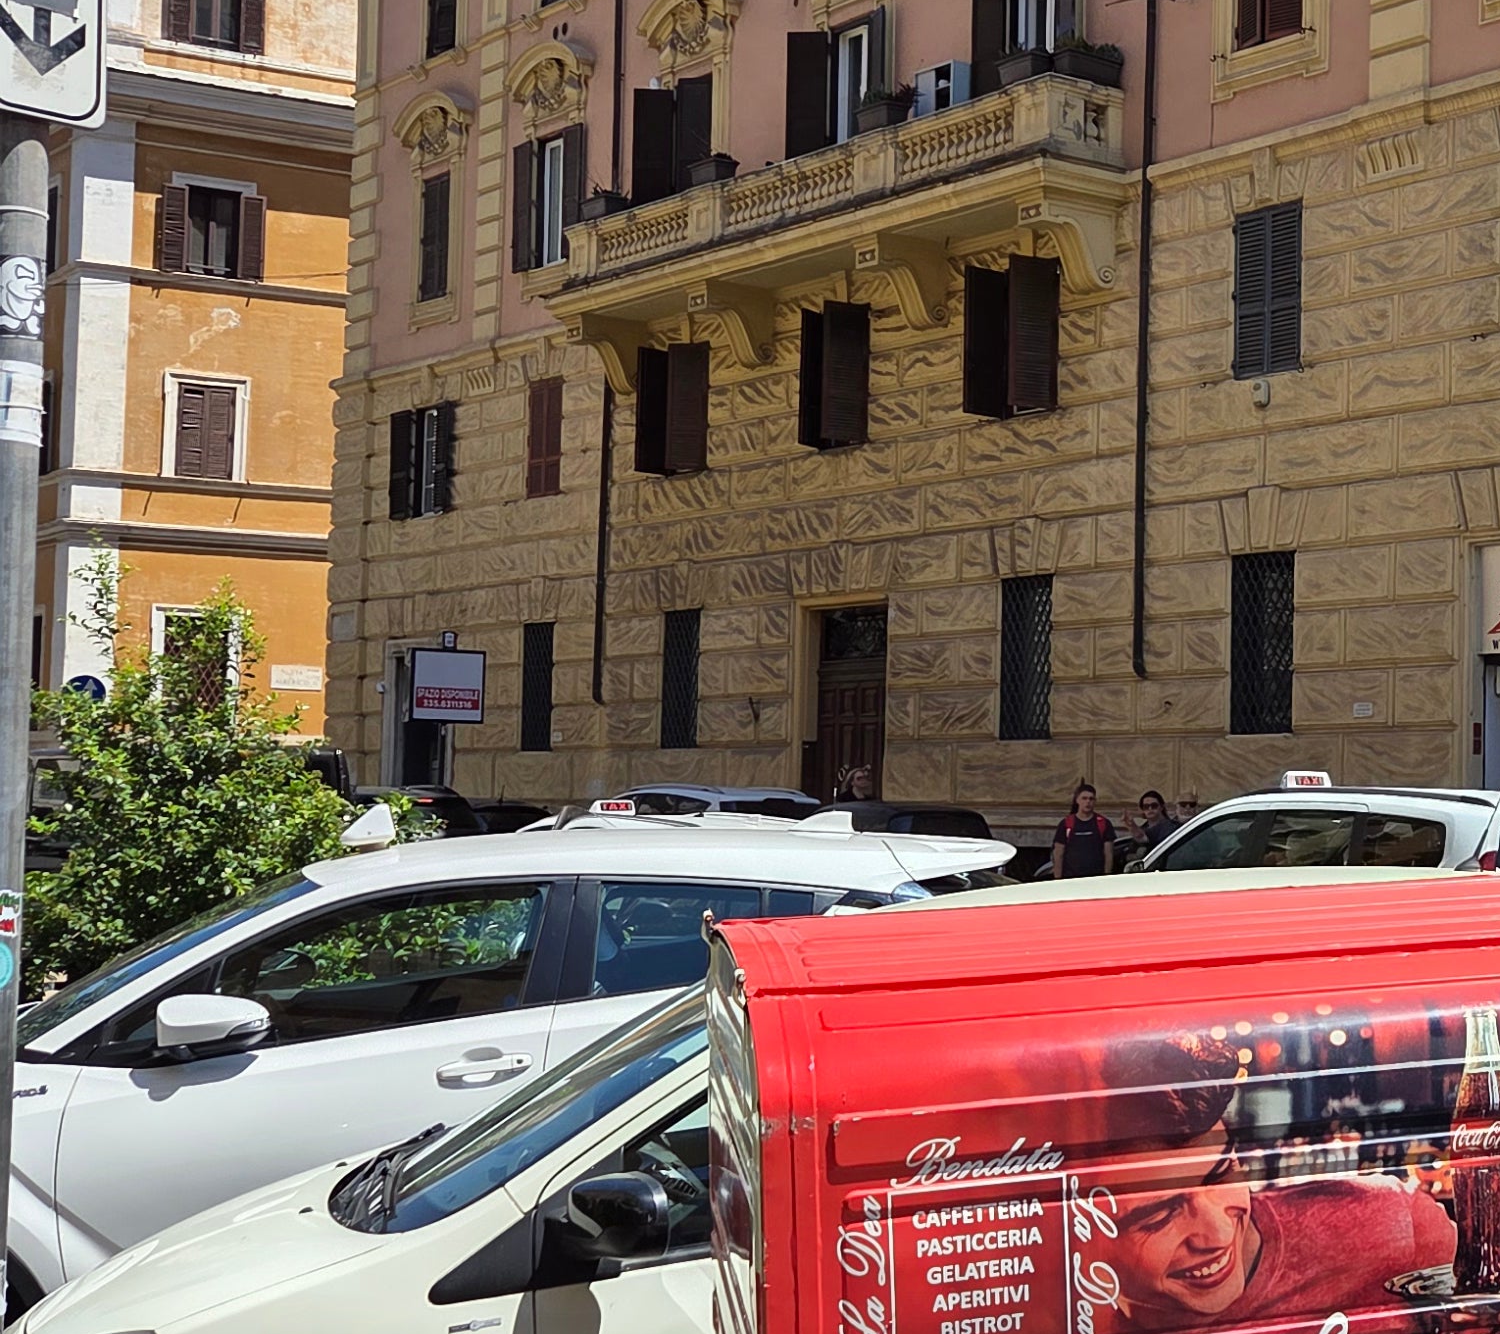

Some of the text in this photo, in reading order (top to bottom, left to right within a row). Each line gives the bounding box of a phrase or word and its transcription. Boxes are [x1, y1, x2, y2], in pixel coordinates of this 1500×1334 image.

[1296, 776, 1324, 785] TAXI
[602, 802, 632, 811] TAXI
[890, 1136, 1066, 1189] Bendata
[911, 1198, 1044, 1229] CAFFETTERIA
[1070, 1175, 1119, 1243] La
[836, 1195, 886, 1286] Dea
[916, 1227, 1043, 1258] PASTICCERIA
[926, 1256, 1035, 1285] GELATERIA
[932, 1284, 1030, 1313] APERITIVI
